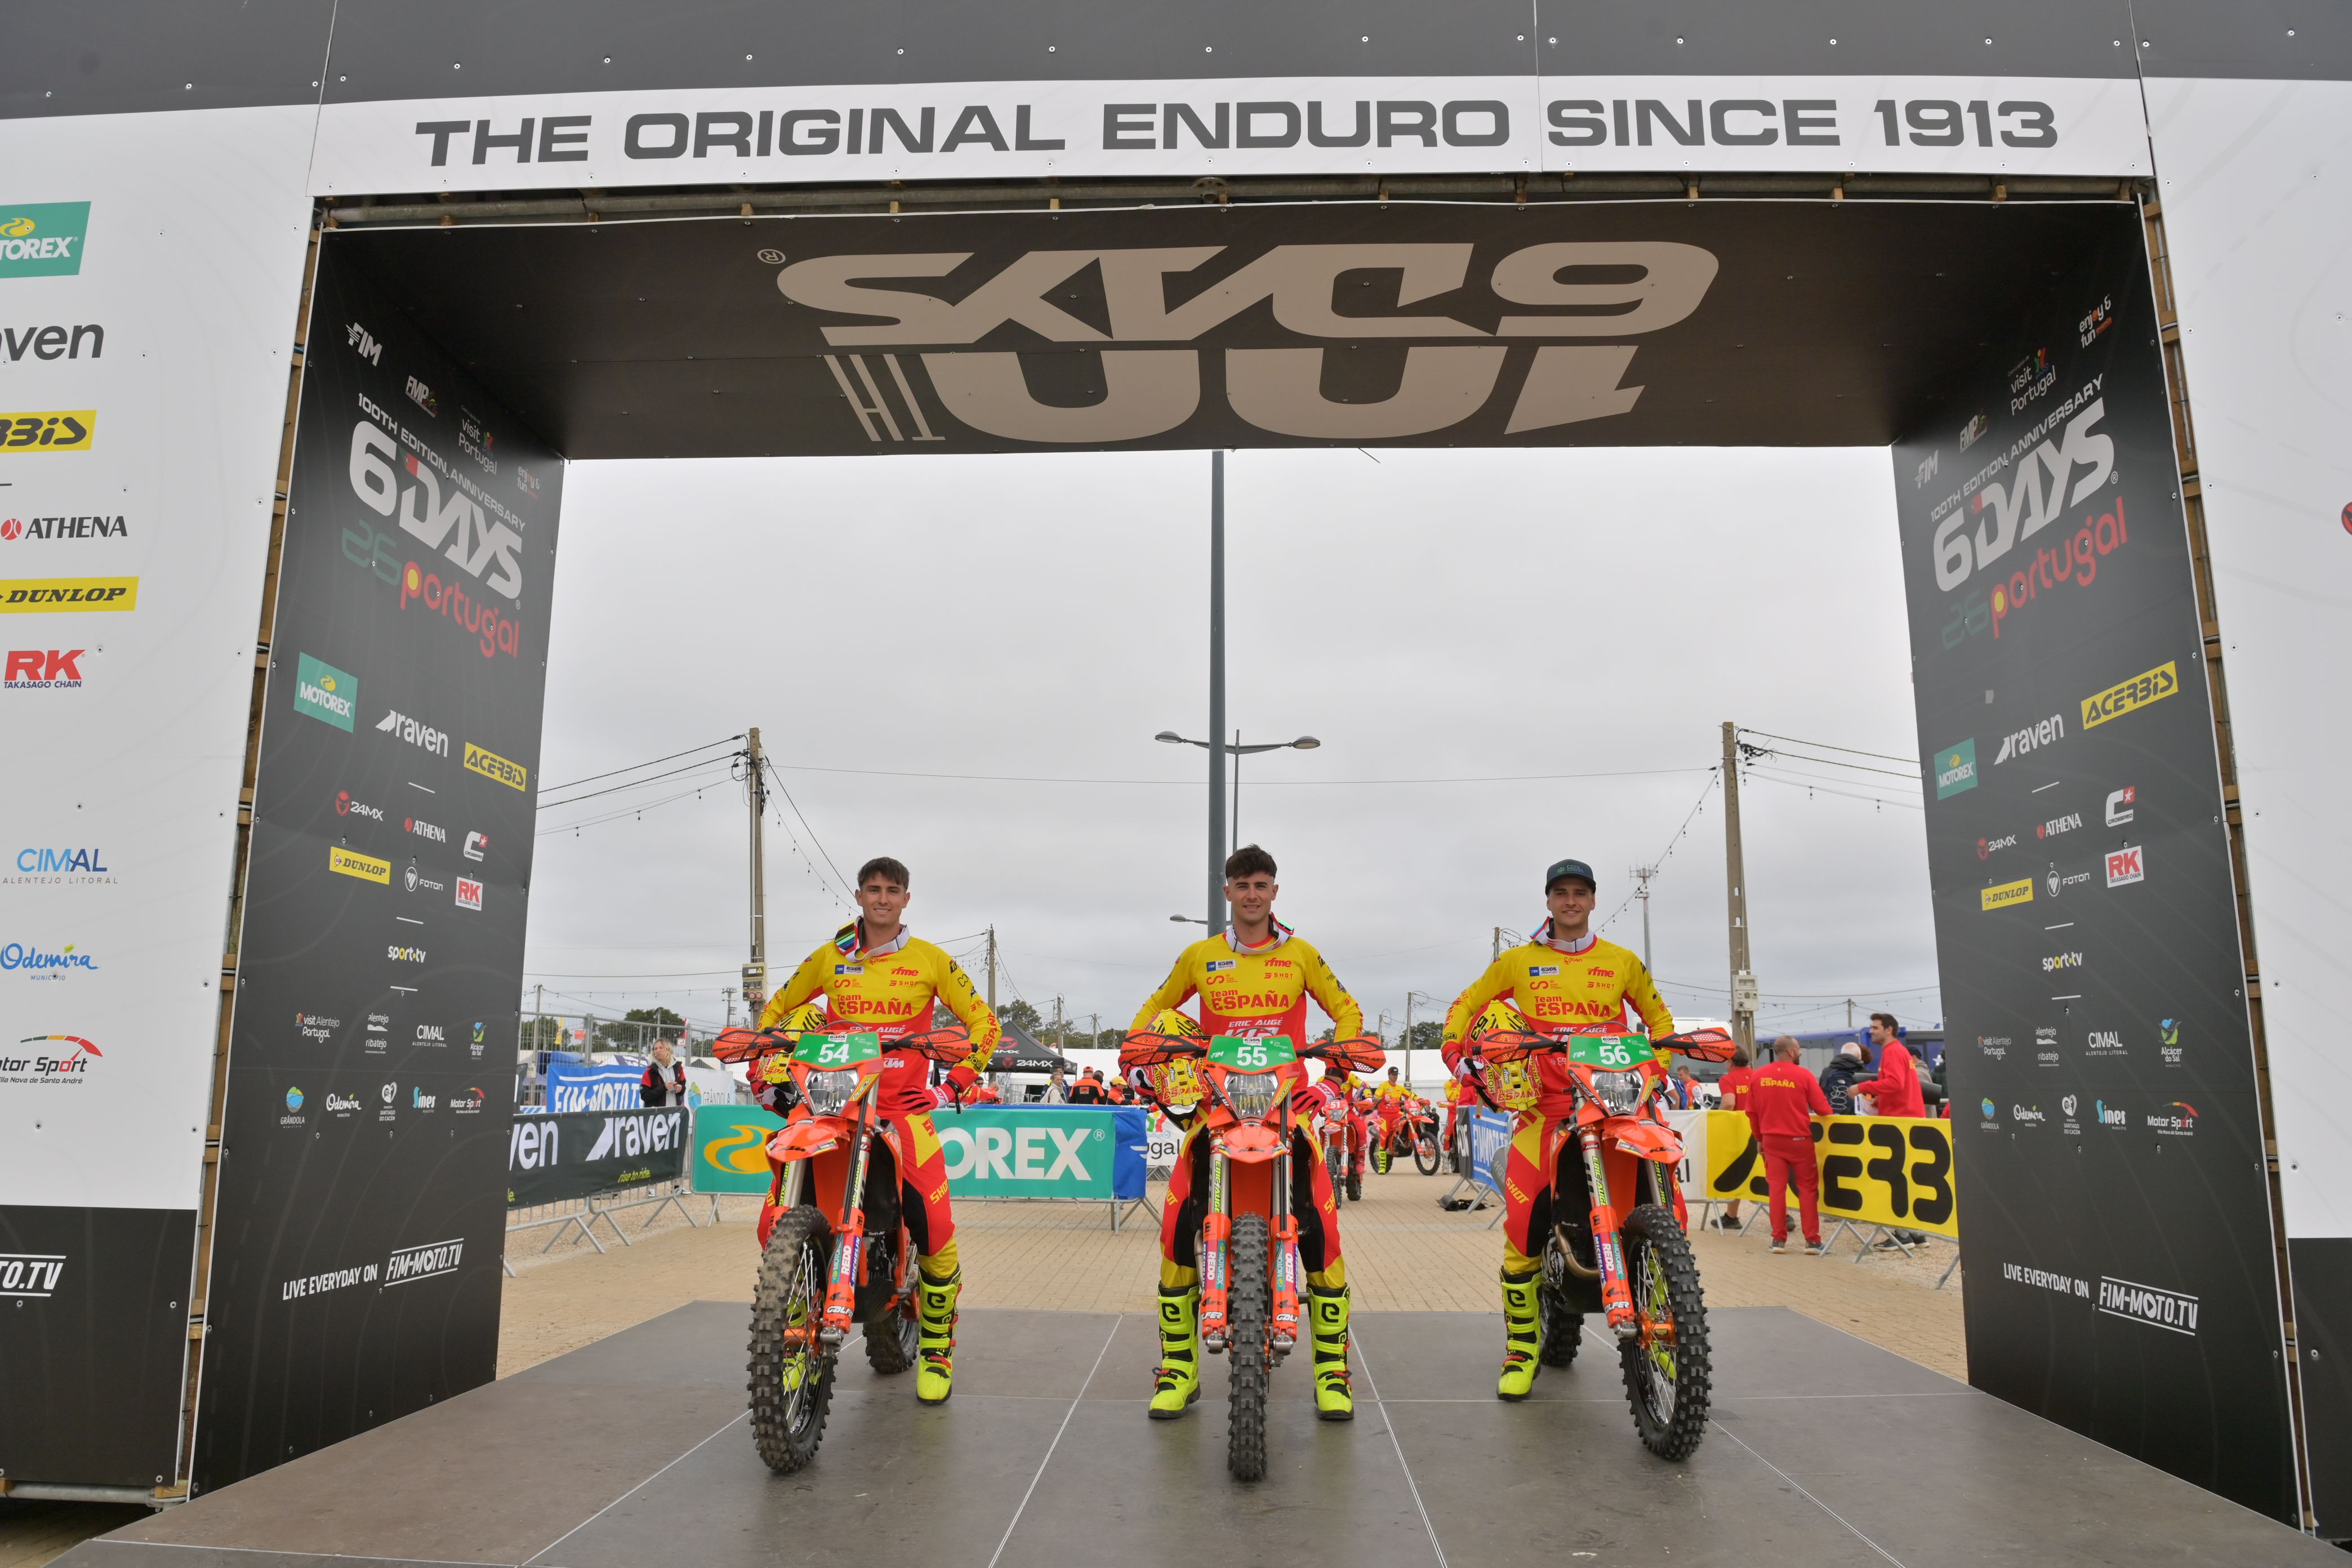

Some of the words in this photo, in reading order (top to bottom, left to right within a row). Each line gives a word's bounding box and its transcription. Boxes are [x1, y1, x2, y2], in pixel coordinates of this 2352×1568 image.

[416, 115, 592, 167] THE
[623, 105, 1066, 159] ORIGINAL
[1103, 100, 1510, 150] ENDURO
[1547, 99, 1841, 146] SINCE
[1873, 99, 2059, 149] 1913
[0, 324, 104, 361] ven
[346, 322, 382, 366] FIM
[2081, 328, 2096, 349] fun
[406, 375, 429, 403] FMP
[2011, 366, 2033, 394] visit
[2011, 365, 2056, 416] Portugal
[462, 418, 480, 443] visit
[1960, 415, 1979, 451] FMP
[458, 432, 497, 475] Portugal
[1931, 489, 1961, 523] 100TH
[1963, 452, 2007, 497] EDITION
[2010, 372, 2103, 460] ANNIVERSARY
[358, 392, 398, 434] 100TH
[400, 426, 447, 474] EDITION
[450, 468, 525, 532] ANNIVERSARY
[1915, 449, 1939, 489] FIM
[517, 476, 527, 493] fun
[1933, 397, 2114, 592] 6DAYS
[349, 420, 522, 599] 6DAYS
[25, 516, 127, 539] ATHENA
[1990, 496, 2127, 639] portugal
[6, 588, 126, 603] DUNLOP
[400, 561, 519, 658] portugal
[5, 649, 86, 681] RK
[300, 681, 350, 718] MOTOREX
[395, 711, 449, 758] raven
[2011, 714, 2064, 758] raven
[1939, 761, 1974, 788] MOTOREX
[350, 801, 384, 822] 24MX
[2108, 813, 2133, 825] CROSSPRO
[413, 819, 446, 843] ATHENA
[2046, 813, 2082, 838] ATHENA
[1988, 835, 2017, 852] 24MX
[17, 848, 108, 872] CIMAL
[343, 858, 386, 876] DUNLOP
[2108, 849, 2140, 878] RK
[419, 878, 443, 891] FOTON
[2063, 872, 2090, 887] FOTON
[458, 880, 481, 903] RK
[1992, 886, 2029, 902] DUNLOP
[0, 943, 100, 970] Odemira
[1210, 990, 1238, 998] Team
[1211, 990, 1289, 1011] ESPAÑA
[838, 997, 912, 1015] ESPAÑA
[1535, 1000, 1611, 1017] ESPAÑA
[304, 1015, 316, 1025] visit
[316, 1016, 340, 1028] Alentejo
[368, 1012, 389, 1025] alentejo
[876, 1024, 906, 1033] AUGÉ
[1255, 1017, 1284, 1026] AUGÉ
[302, 1026, 331, 1043] Portugal
[417, 1024, 444, 1040] CIMAL
[1983, 1037, 1993, 1045] visit
[1993, 1036, 2012, 1046] Alentejo
[2035, 1026, 2056, 1038] alentejo
[2088, 1031, 2123, 1048] CIMAL
[366, 1039, 387, 1050] ribatejo
[818, 1044, 849, 1063] 54
[1237, 1046, 1267, 1066] 55
[1599, 1045, 1631, 1065] 56
[1984, 1046, 2006, 1061] Portugal
[2161, 1046, 2182, 1055] Alcácer
[34, 1057, 87, 1076] Sport
[884, 1058, 905, 1068] KTM
[2038, 1051, 2059, 1063] ribatejo
[1486, 1064, 1495, 1093] AIROH
[1761, 1079, 1796, 1089] ESPAÑA
[326, 1093, 362, 1111] Odemira
[413, 1086, 436, 1108] Sines
[1163, 1084, 1209, 1099] ESPAÑA
[1498, 1088, 1541, 1102] ESPAÑA
[450, 1099, 466, 1108] Motor
[2013, 1104, 2046, 1121] Odemira
[2096, 1099, 2126, 1125] Sines
[280, 1115, 305, 1124] GRÂNDOLA
[2147, 1115, 2170, 1126] Motor
[2171, 1116, 2193, 1130] Sport
[614, 1112, 681, 1157] raven
[618, 1170, 632, 1183] rise
[632, 1170, 639, 1179] to
[1592, 1156, 1602, 1180] ERIC
[1505, 1177, 1529, 1204] SHOT
[840, 1245, 852, 1275] REDD
[851, 1236, 861, 1282] MICHELIN
[1207, 1251, 1217, 1280] REDD
[1217, 1252, 1225, 1285] MOTOREX
[1285, 1252, 1294, 1284] REDD
[1594, 1236, 1605, 1282] MICHELIN
[1602, 1242, 1614, 1272] REDD
[1614, 1243, 1624, 1275] MOTOREX
[283, 1277, 307, 1300] LIVE
[309, 1267, 362, 1295] EVERYDAY
[363, 1263, 378, 1282] ON
[385, 1243, 463, 1281] FIM-MOTO.TV
[2003, 1262, 2023, 1282] LIVE
[2024, 1267, 2071, 1294] EVERYDAY
[2074, 1279, 2090, 1299] ON
[2100, 1282, 2198, 1329] FIM-MOTO.TV
